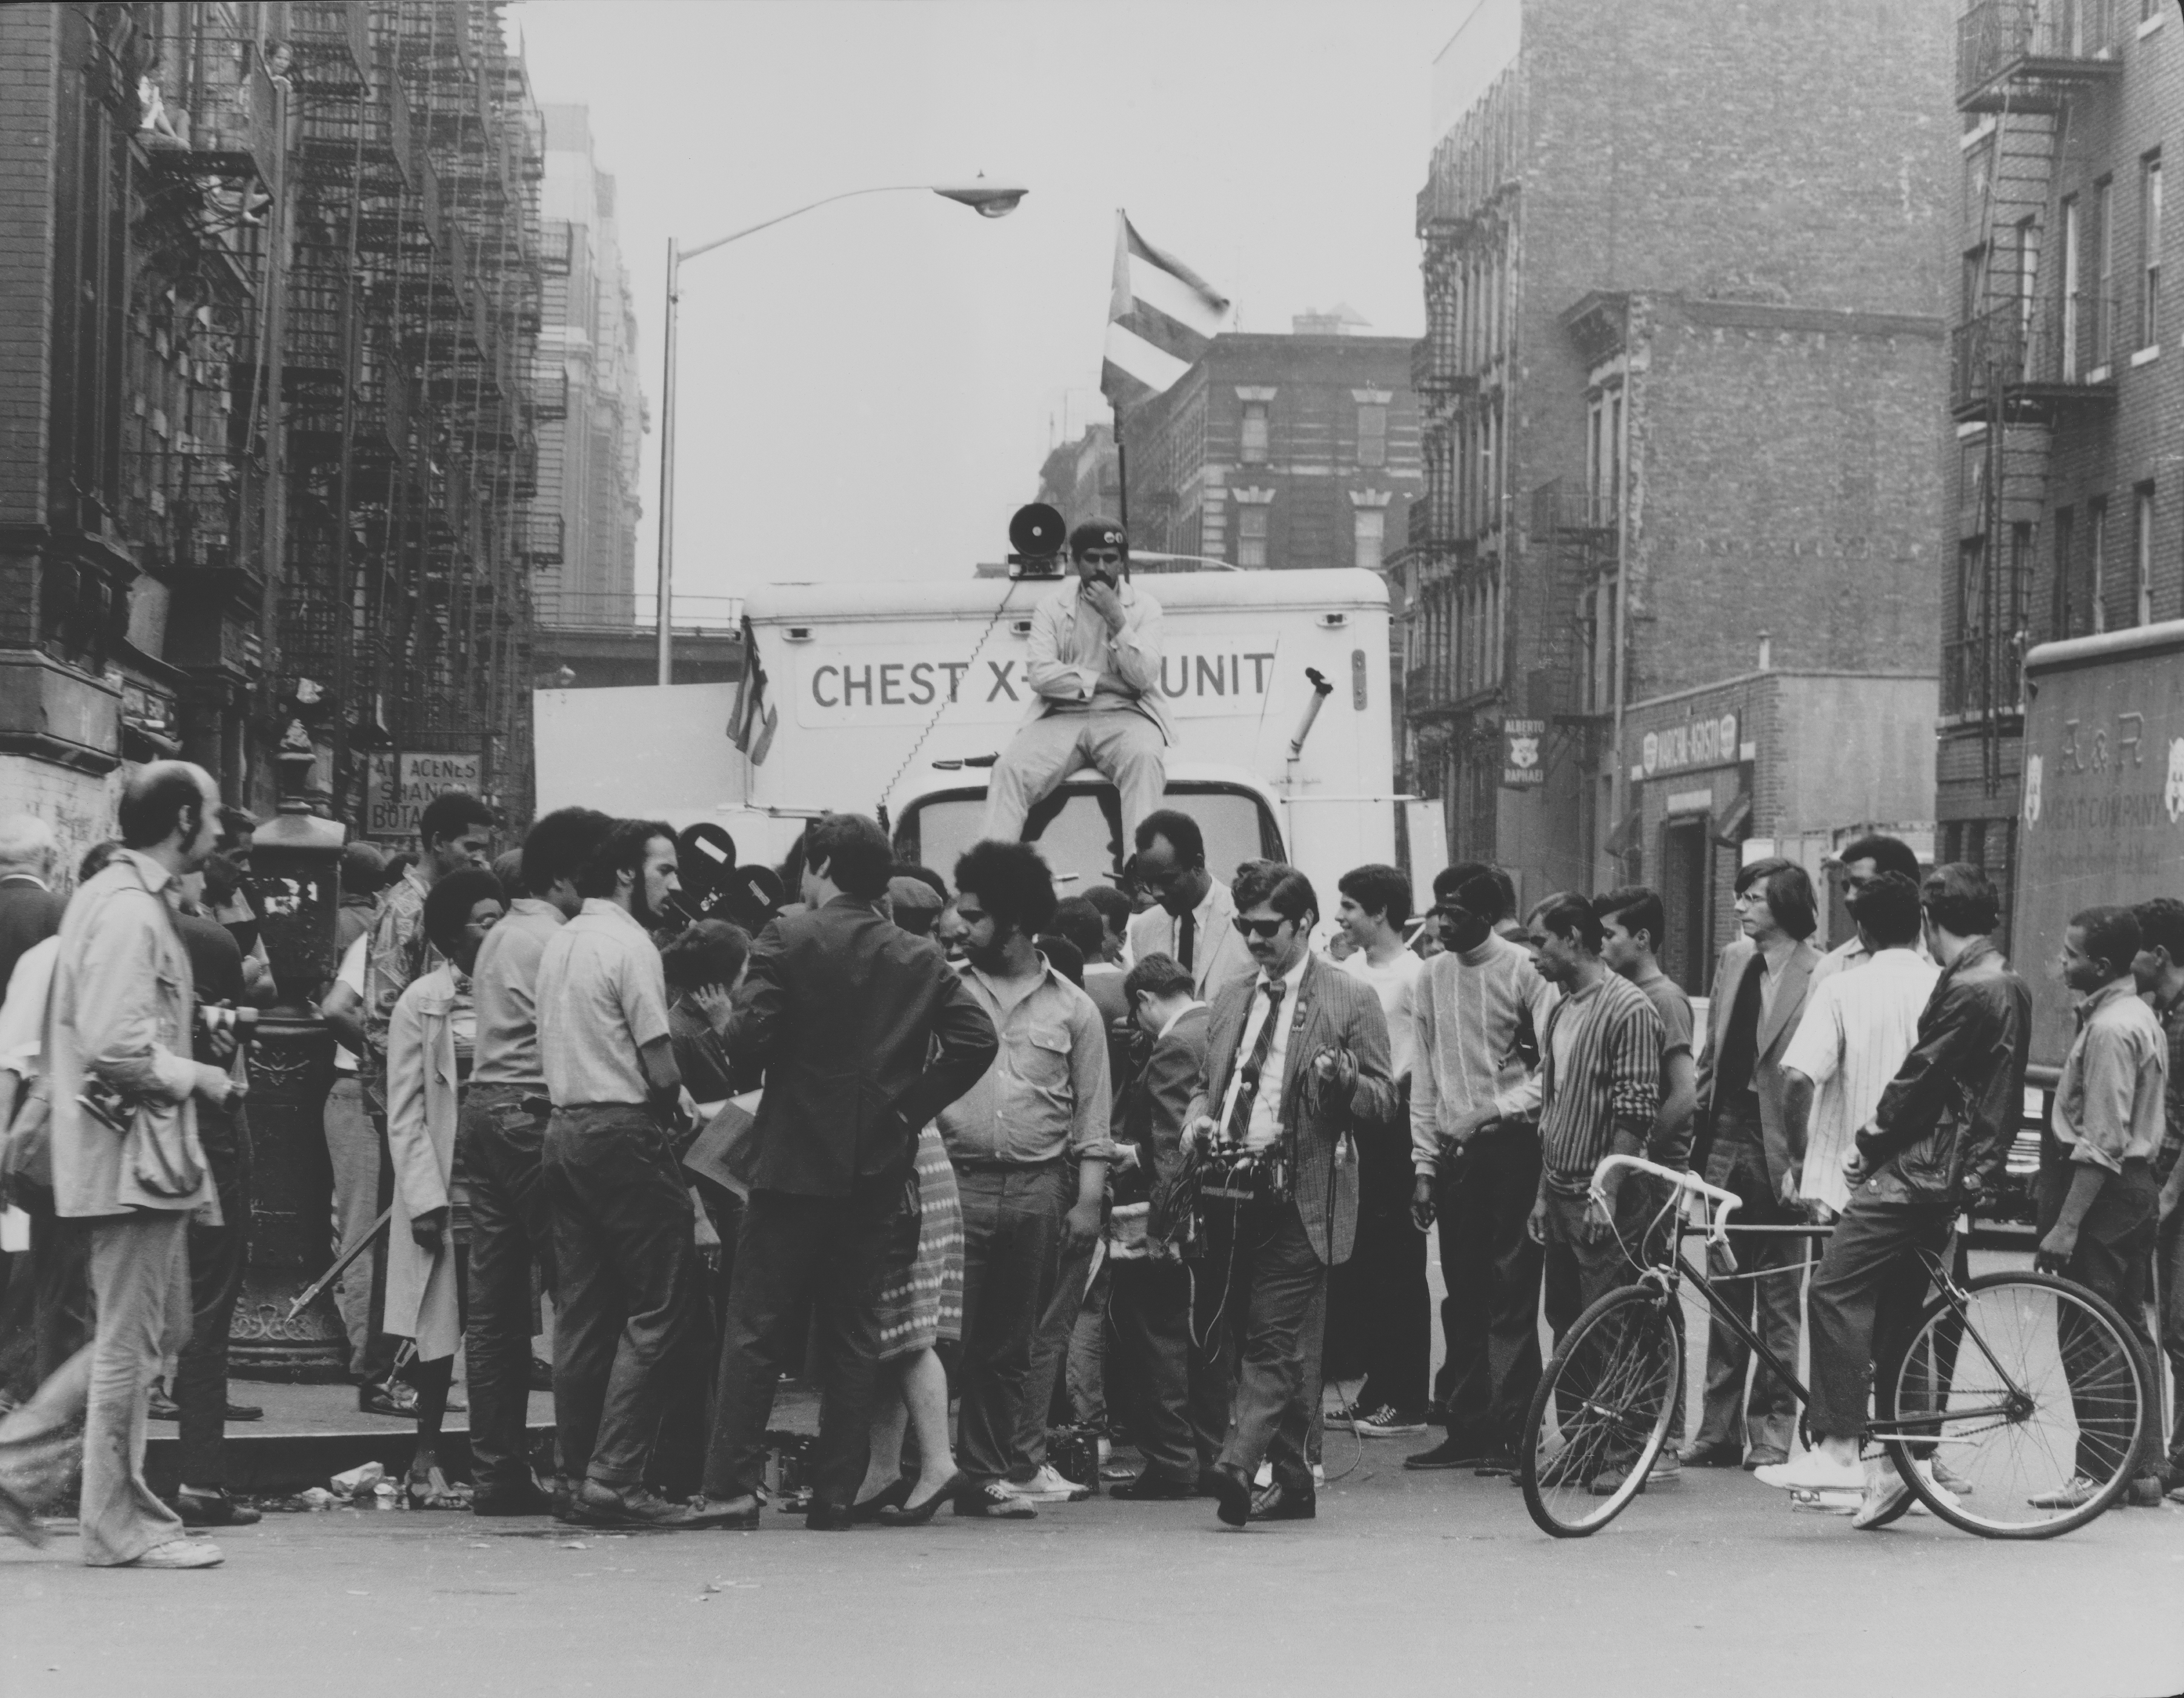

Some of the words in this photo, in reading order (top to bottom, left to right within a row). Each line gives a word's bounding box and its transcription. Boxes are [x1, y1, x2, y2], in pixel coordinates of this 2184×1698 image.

[812, 662, 969, 707] CHEST
[1160, 653, 1274, 698] UNIT
[1505, 720, 1545, 734] ALBERTO
[2115, 711, 2145, 771] R
